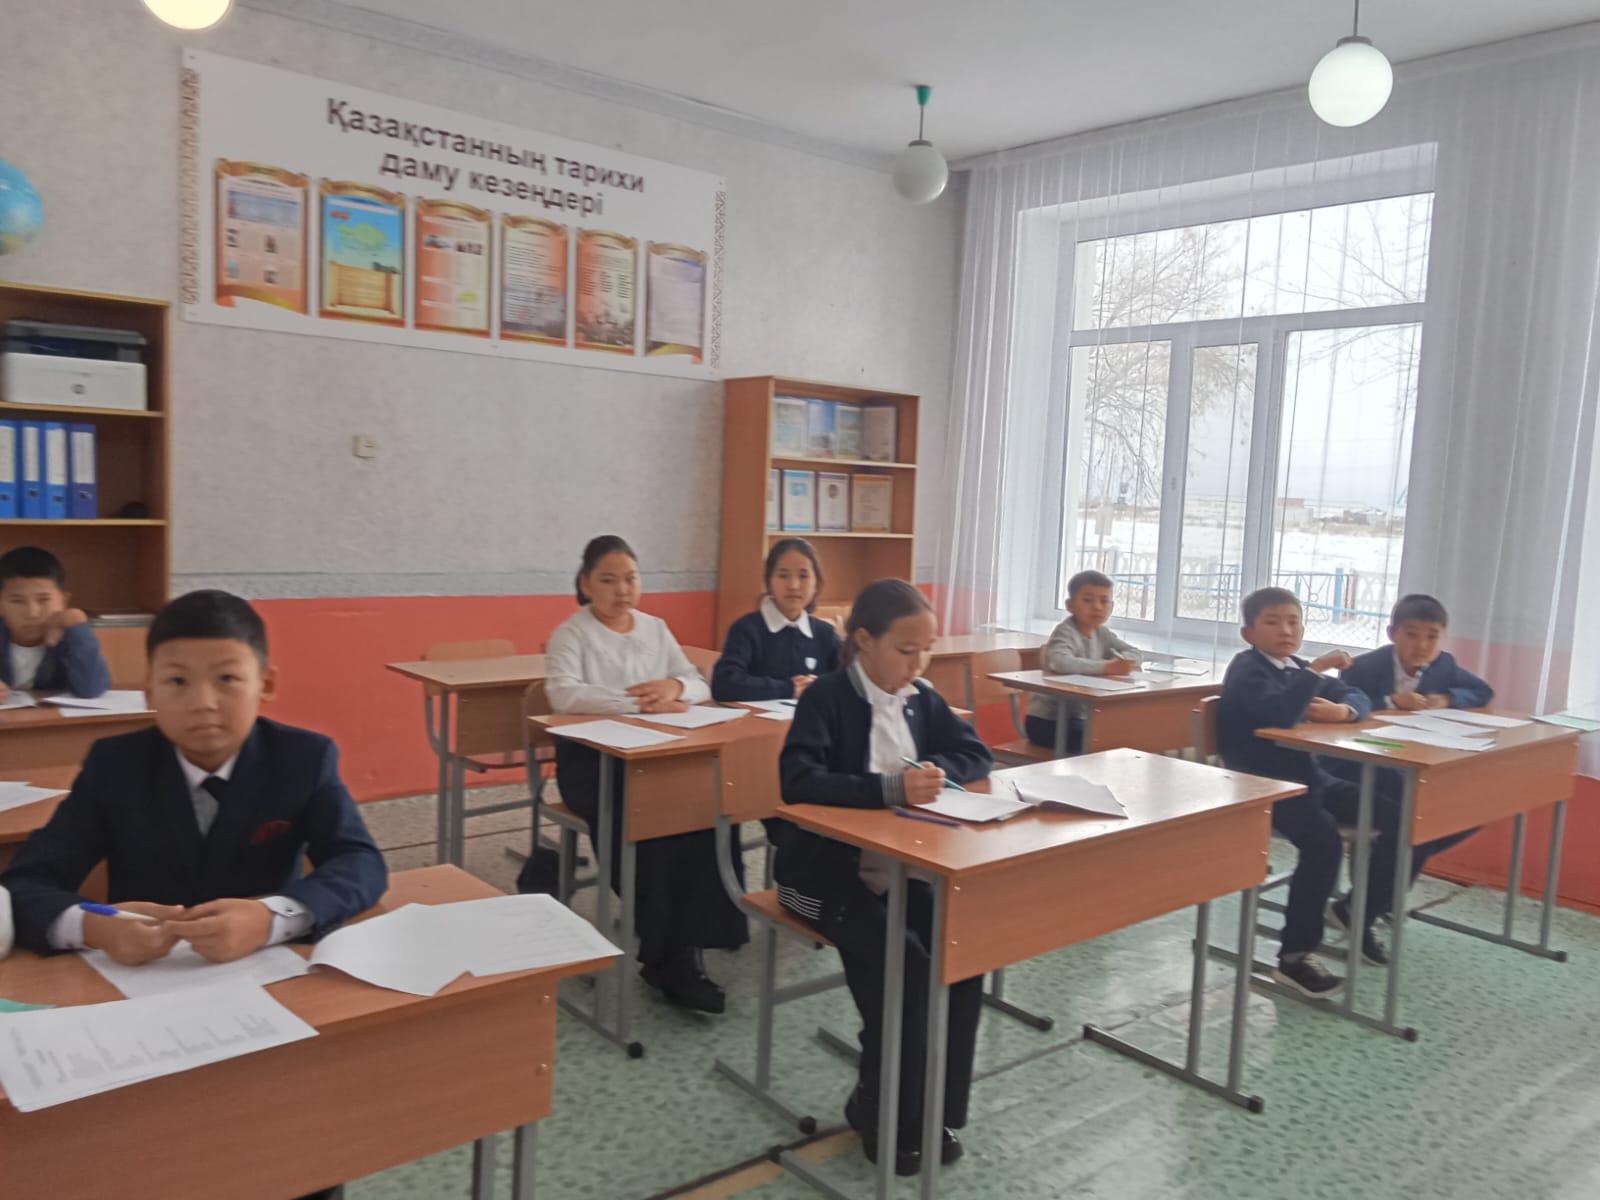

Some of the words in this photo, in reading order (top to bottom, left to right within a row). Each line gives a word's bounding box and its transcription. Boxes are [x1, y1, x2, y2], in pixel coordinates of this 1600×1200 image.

[327, 98, 547, 175] Қазақстанның
[554, 156, 645, 193] тарихи
[379, 152, 460, 191] даму
[469, 170, 604, 218] кезеңдері
